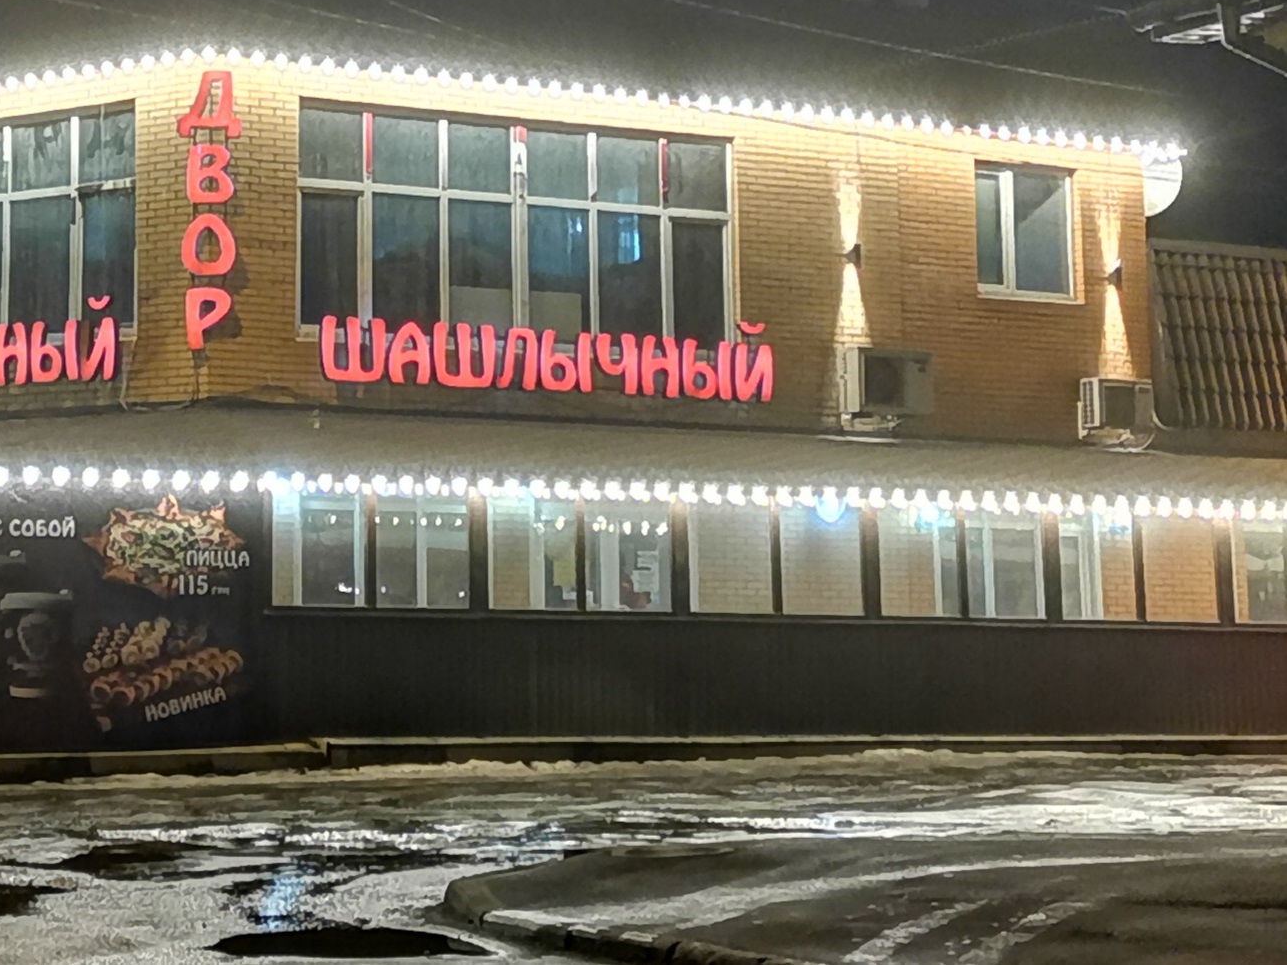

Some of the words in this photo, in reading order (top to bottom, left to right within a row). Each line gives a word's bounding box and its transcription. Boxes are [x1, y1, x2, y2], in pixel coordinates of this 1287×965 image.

[176, 70, 241, 350] ДВОР
[319, 314, 776, 404] ШАШЛЫЧНЫЙ
[9, 515, 75, 538] СОБОЙ
[186, 548, 250, 569] ПИЦЦА
[178, 574, 209, 596] 115
[145, 686, 227, 722] НОВИНКА
